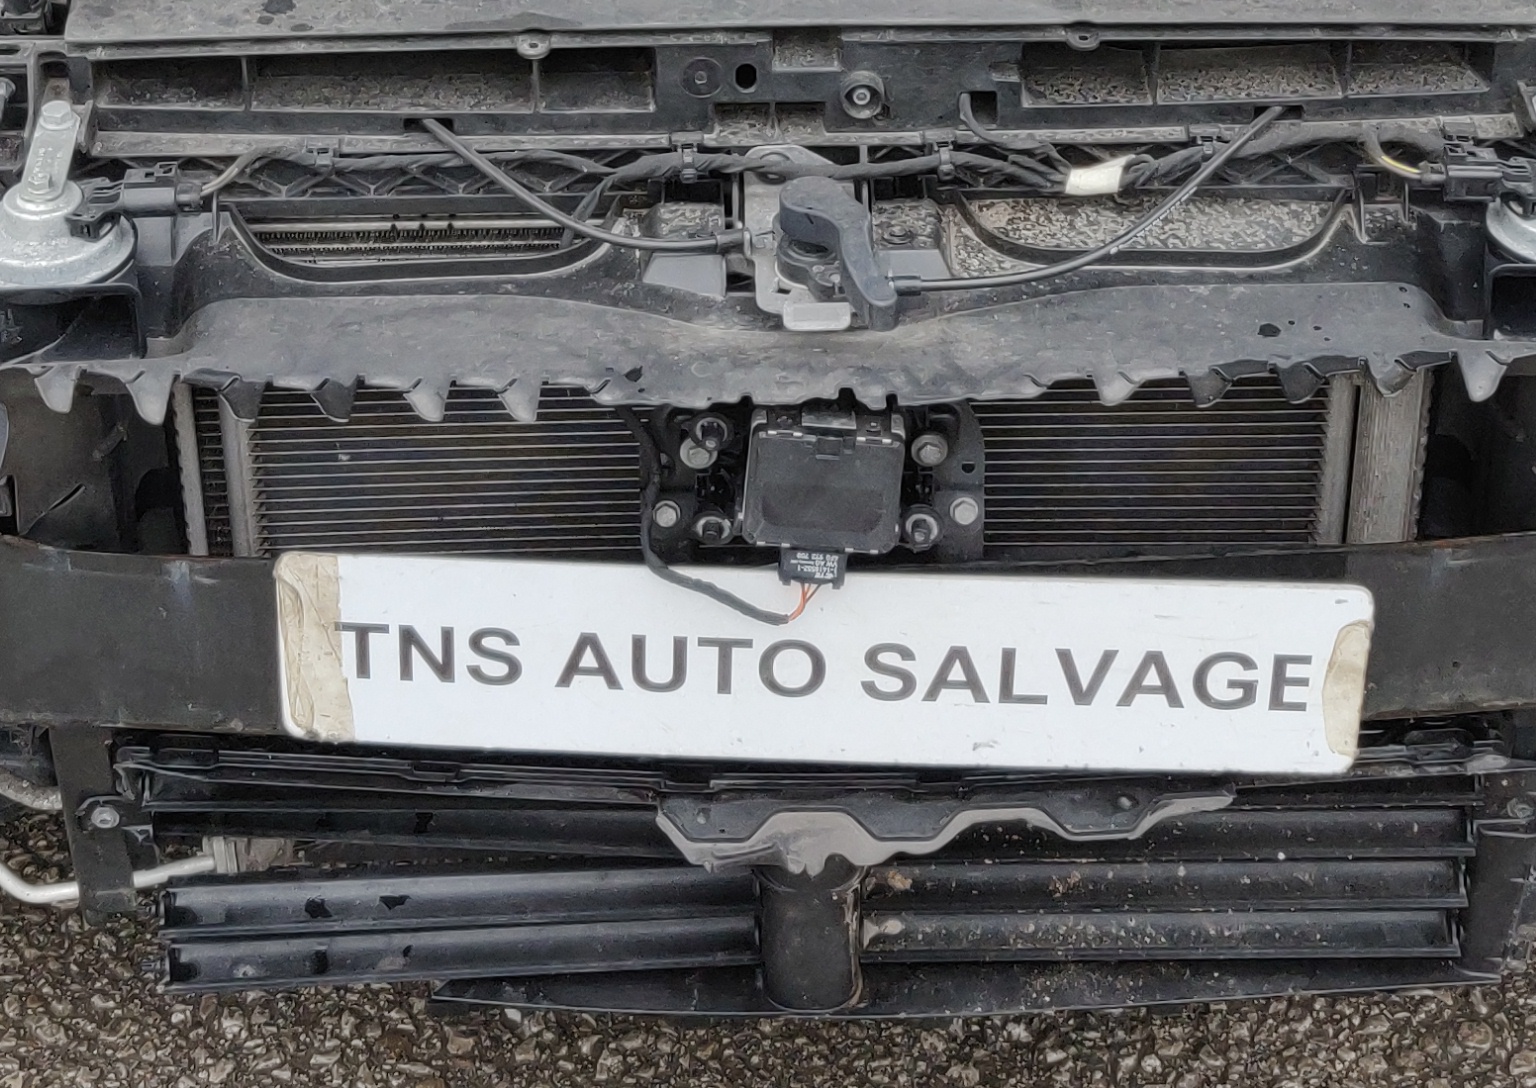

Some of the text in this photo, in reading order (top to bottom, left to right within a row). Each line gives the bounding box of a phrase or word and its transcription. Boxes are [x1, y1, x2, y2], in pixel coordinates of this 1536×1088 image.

[334, 621, 1313, 712] TNS AUTO SALVAGE
